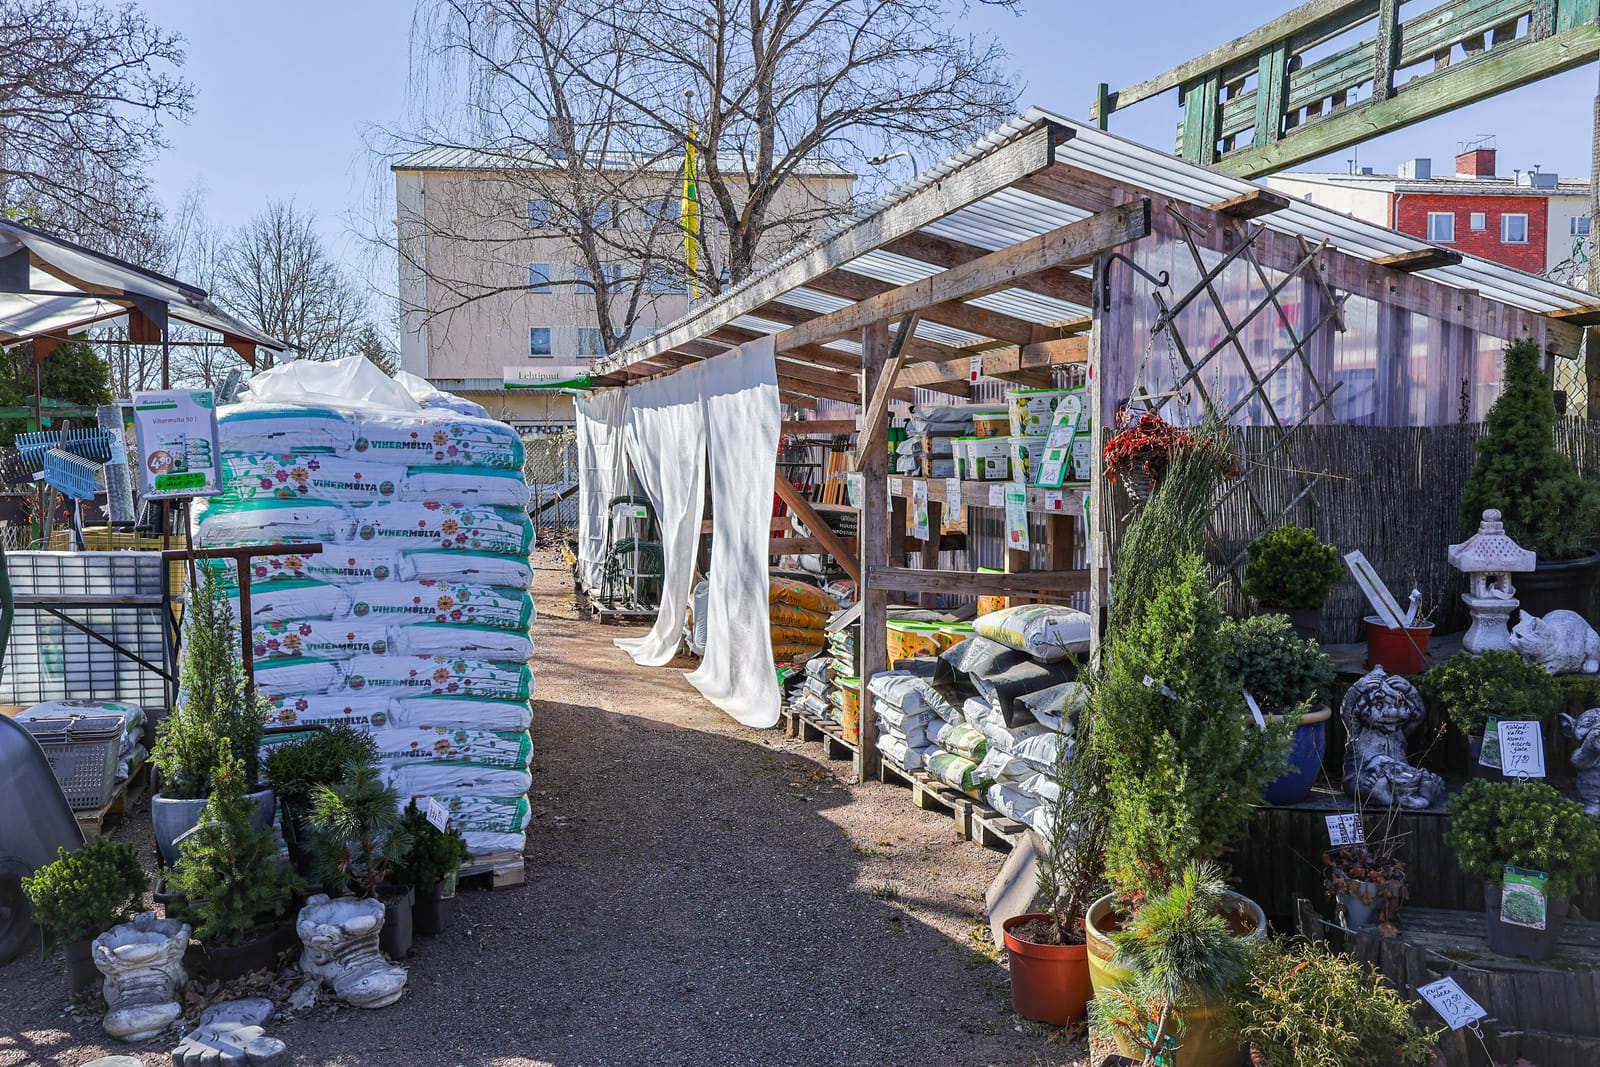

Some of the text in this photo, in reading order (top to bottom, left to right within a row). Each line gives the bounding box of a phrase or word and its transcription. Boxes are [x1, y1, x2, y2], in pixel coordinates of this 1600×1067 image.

[518, 371, 560, 382] Lehtipuut
[371, 440, 433, 450] VIHERMULTA
[313, 479, 377, 491] VIHERMULTA
[377, 528, 441, 538] VIHERMULTA
[372, 605, 436, 615] VIHERMULTA
[306, 642, 370, 652] VIHERMULTA
[368, 677, 431, 688] VIHERMULTA
[376, 749, 433, 758] IHERMULTA
